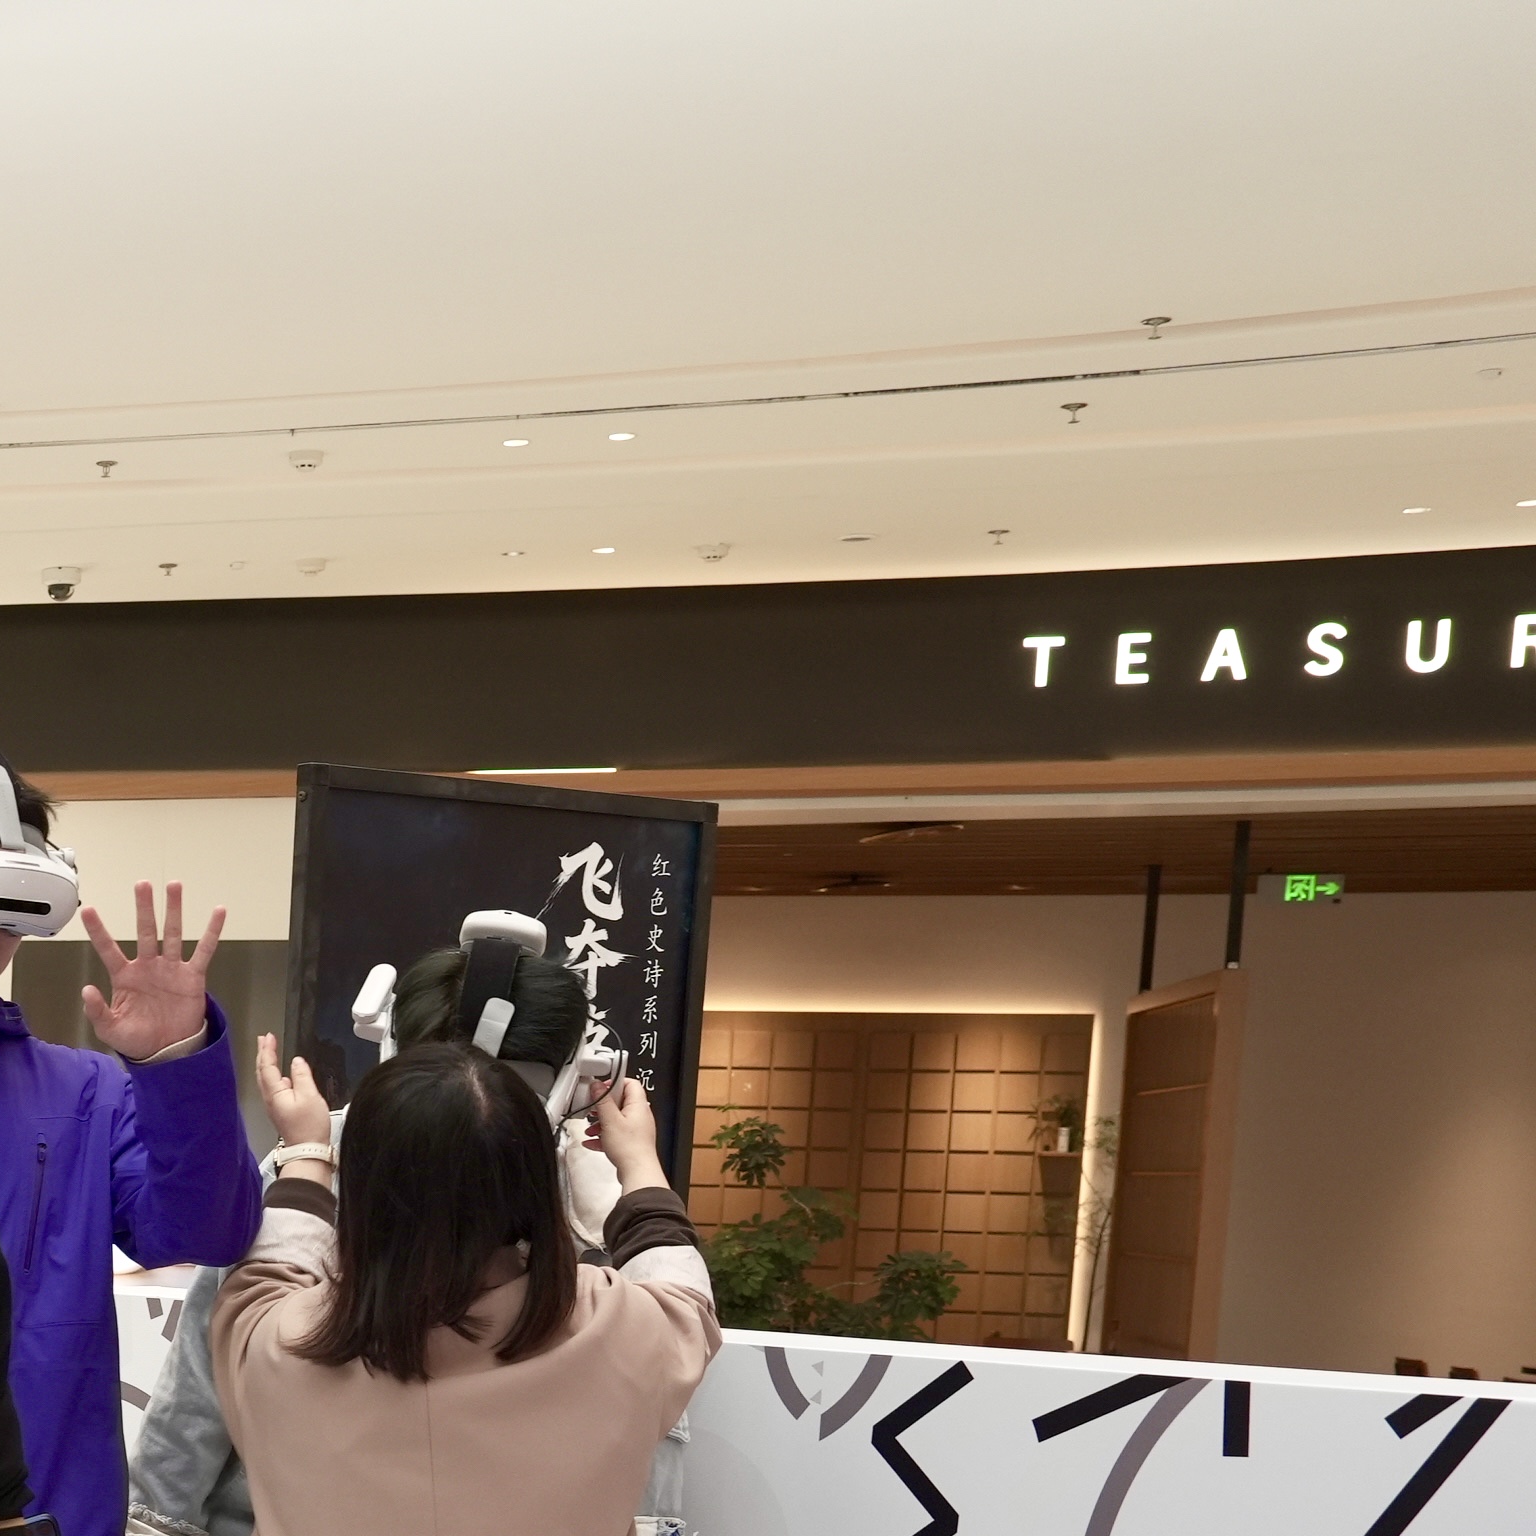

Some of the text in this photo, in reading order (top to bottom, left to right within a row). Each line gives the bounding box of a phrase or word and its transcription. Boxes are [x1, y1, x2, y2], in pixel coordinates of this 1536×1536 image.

[635, 853, 672, 1105] 红色史诗系列沉
